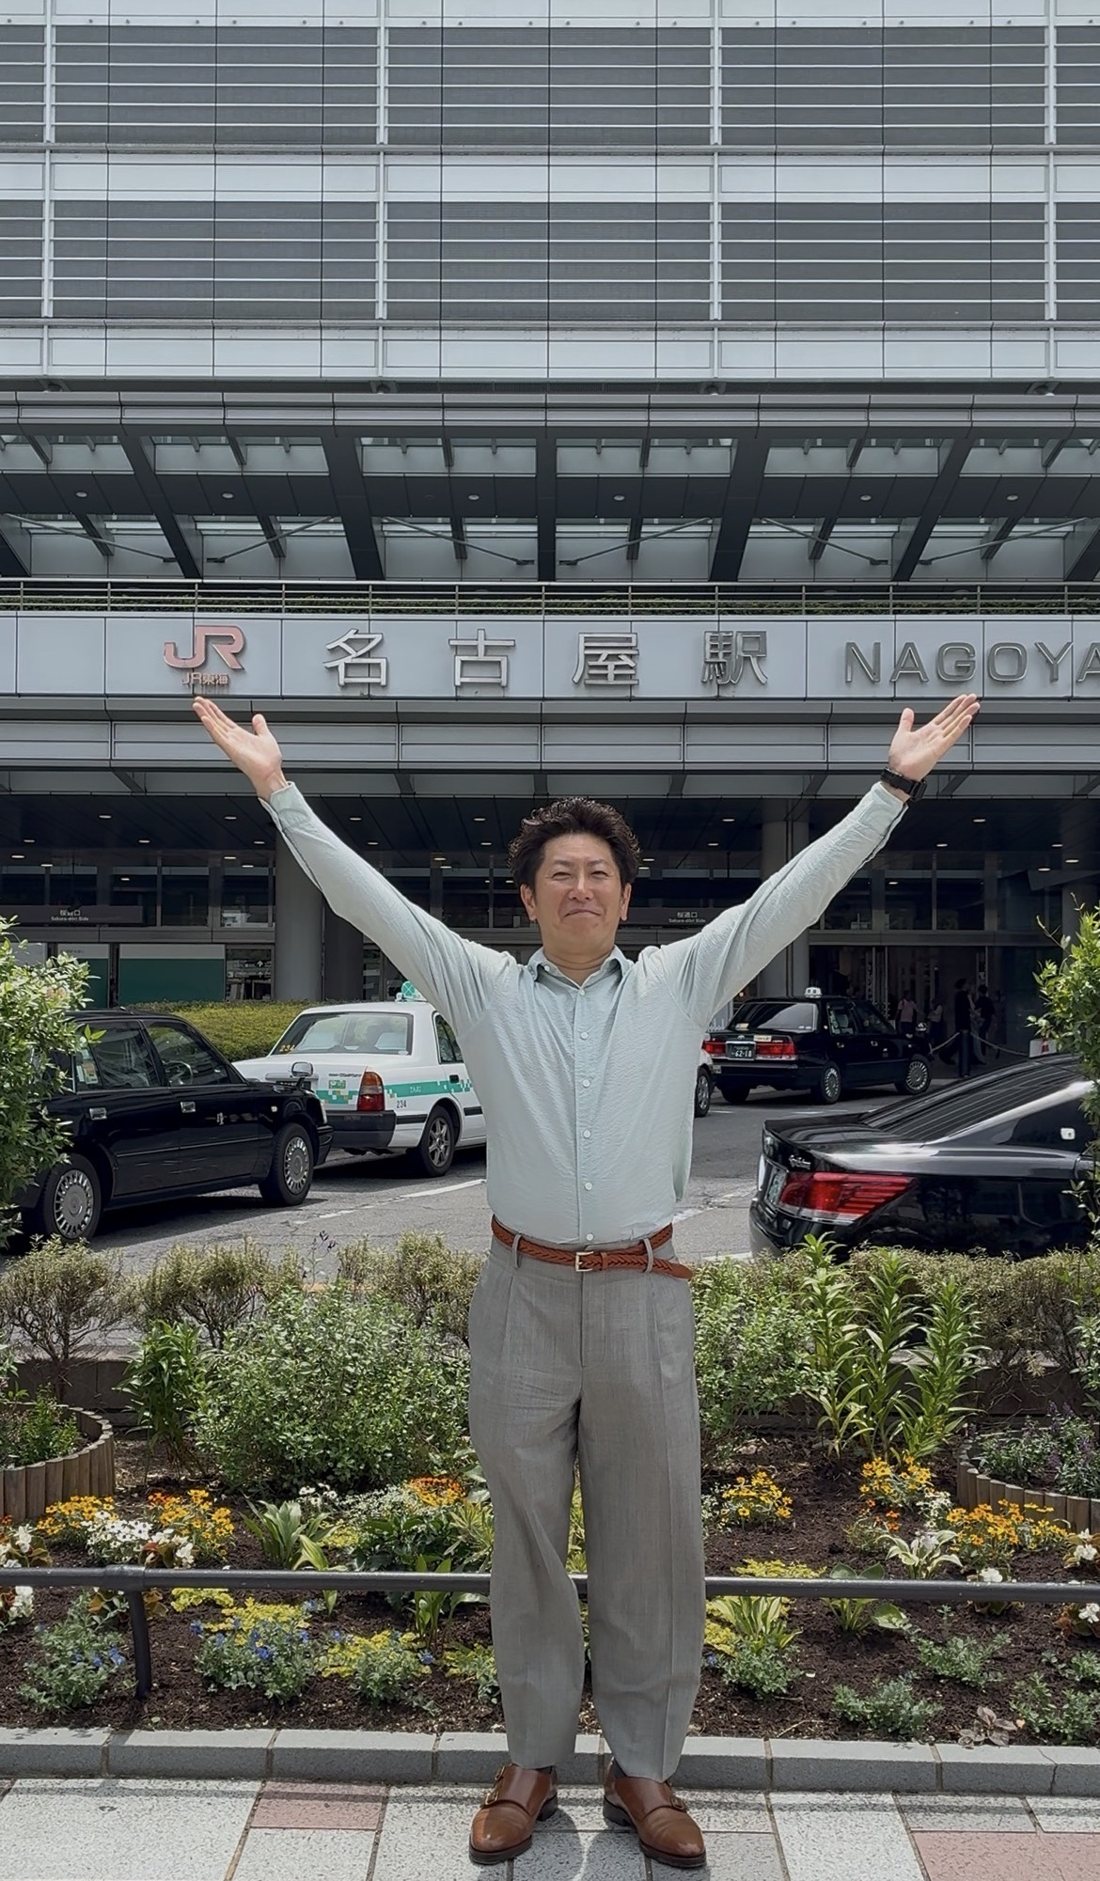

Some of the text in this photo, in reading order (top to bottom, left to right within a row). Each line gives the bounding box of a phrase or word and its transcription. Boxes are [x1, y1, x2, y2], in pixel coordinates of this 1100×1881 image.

[163, 624, 245, 671] JR
[322, 627, 768, 688] 名古屋駅
[844, 641, 1100, 684] NAGOYA
[182, 672, 230, 688] JR東海
